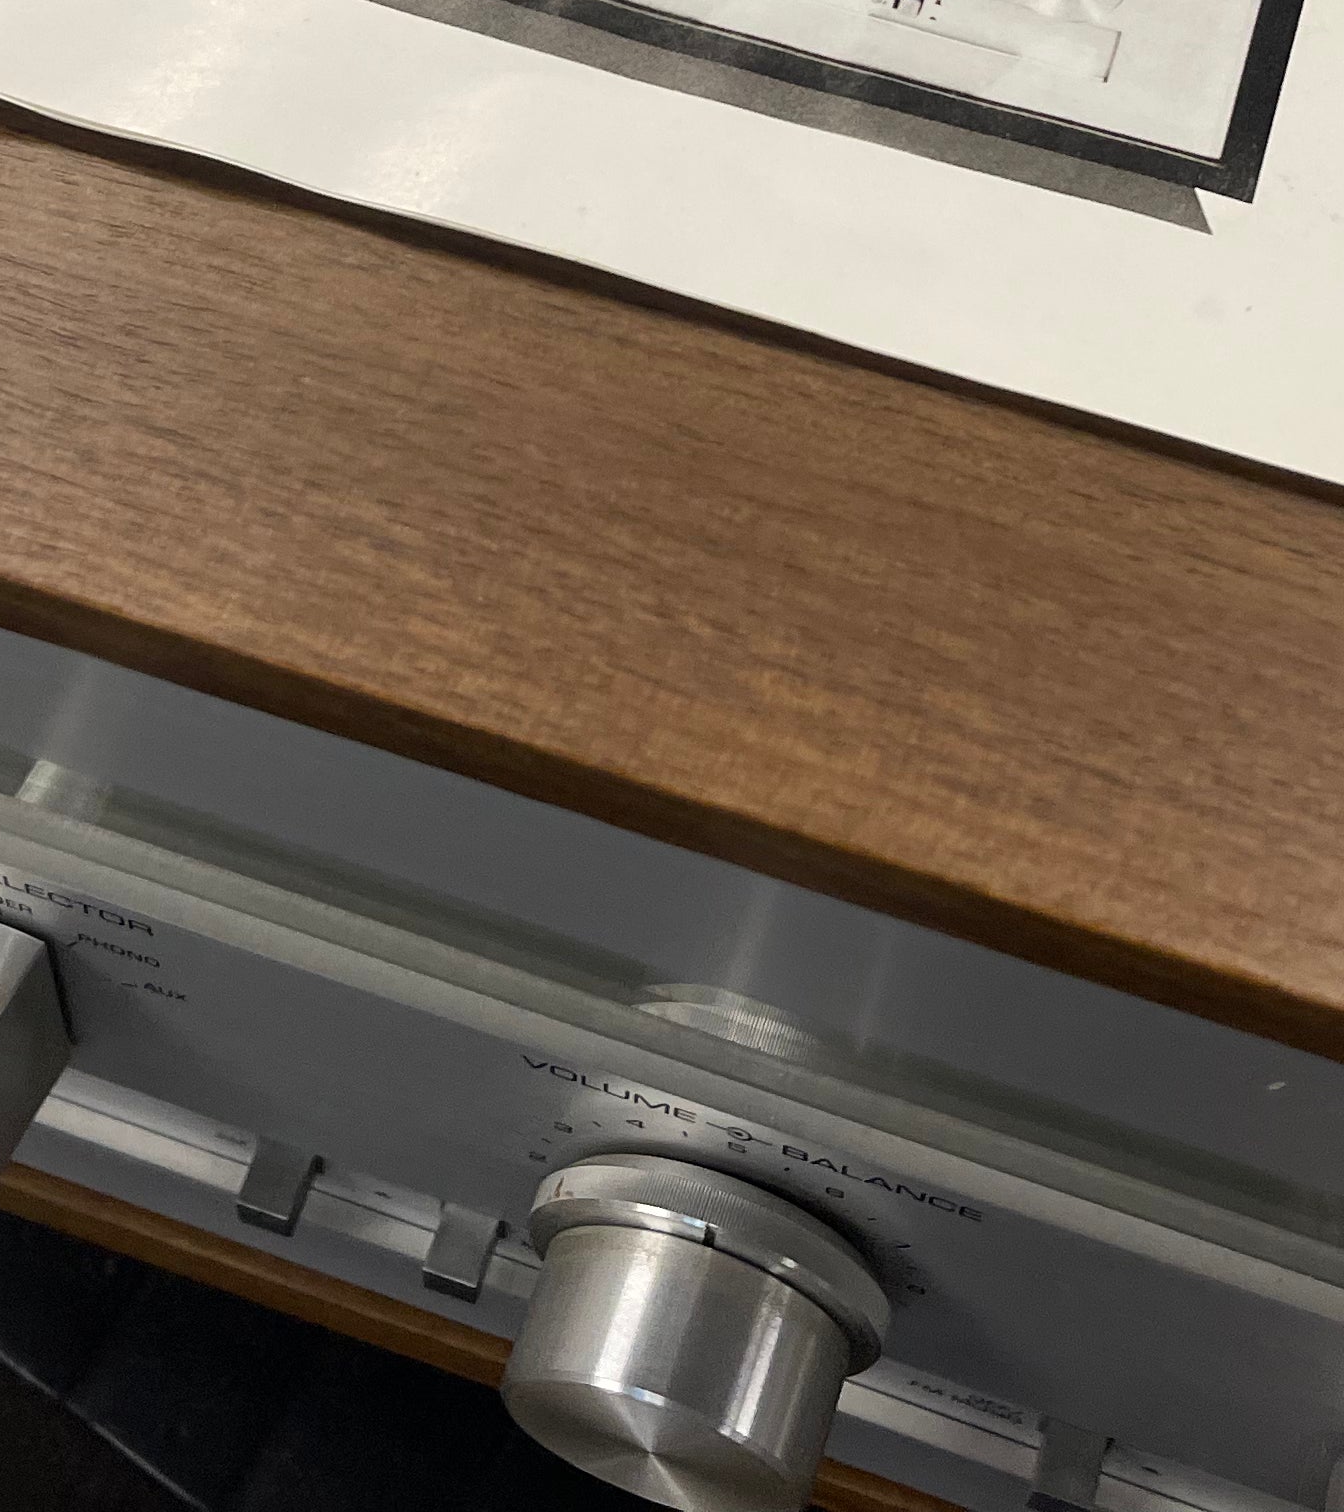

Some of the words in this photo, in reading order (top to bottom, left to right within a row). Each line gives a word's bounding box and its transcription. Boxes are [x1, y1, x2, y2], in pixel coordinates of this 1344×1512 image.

[77, 932, 161, 969] PHONO
[143, 982, 188, 1002] AUX
[522, 1053, 699, 1124] VOLUME
[781, 1143, 984, 1223] BALANCE
